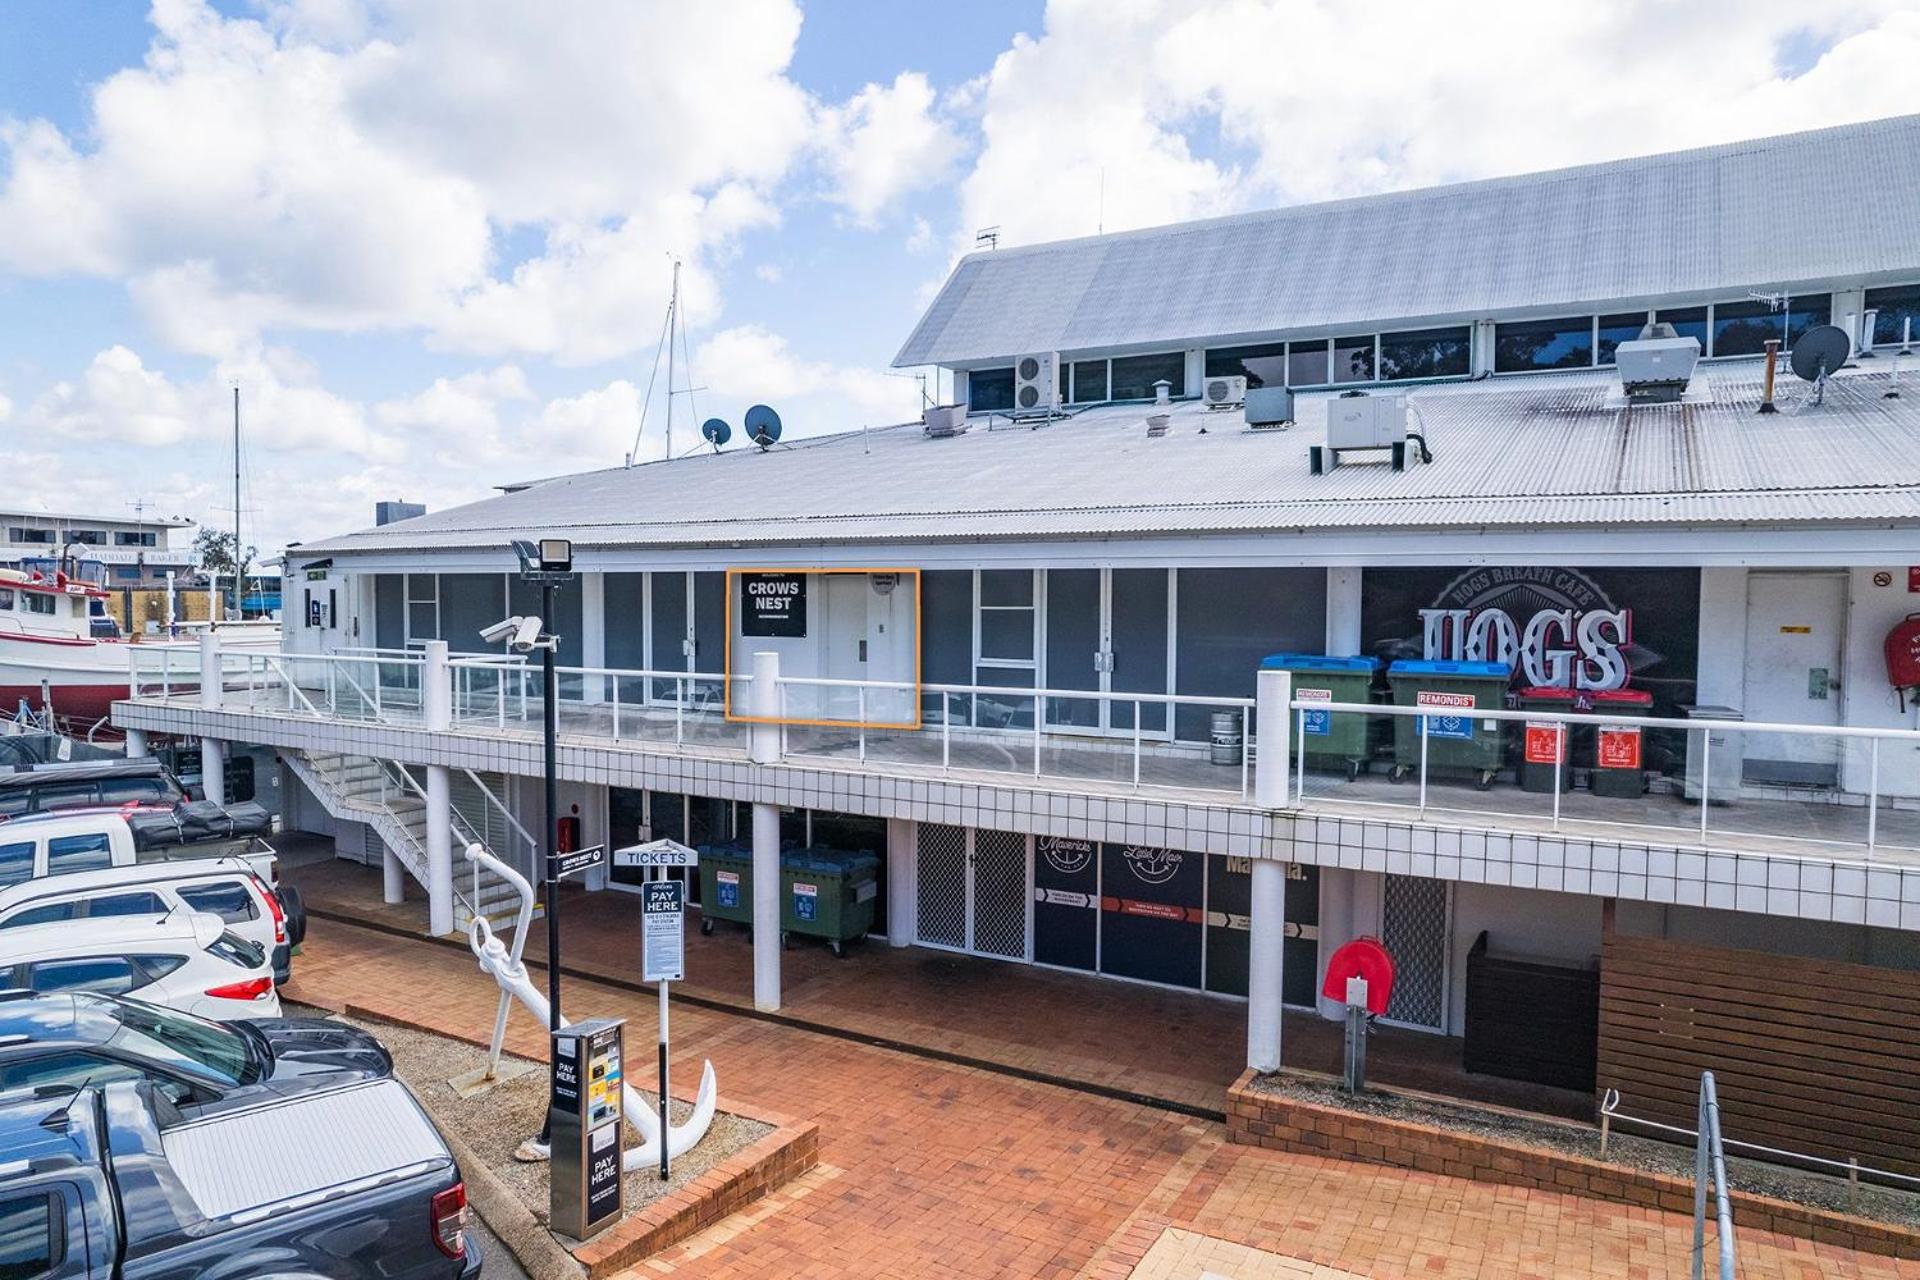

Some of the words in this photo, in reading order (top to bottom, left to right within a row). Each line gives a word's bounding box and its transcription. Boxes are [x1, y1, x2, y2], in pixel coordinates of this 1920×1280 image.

[748, 582, 799, 594] CROWS
[1451, 573, 1491, 605] HOGS
[1491, 566, 1554, 584] BREATH
[755, 597, 792, 610] NEST
[1420, 694, 1470, 707] REMONDIS
[628, 853, 687, 864] TICKETS
[651, 891, 674, 901] PAY
[647, 901, 679, 912] HERE
[558, 1062, 574, 1073] PAY
[556, 1070, 577, 1083] HERE
[594, 1155, 613, 1173] PAY
[591, 1164, 616, 1185] HERE
